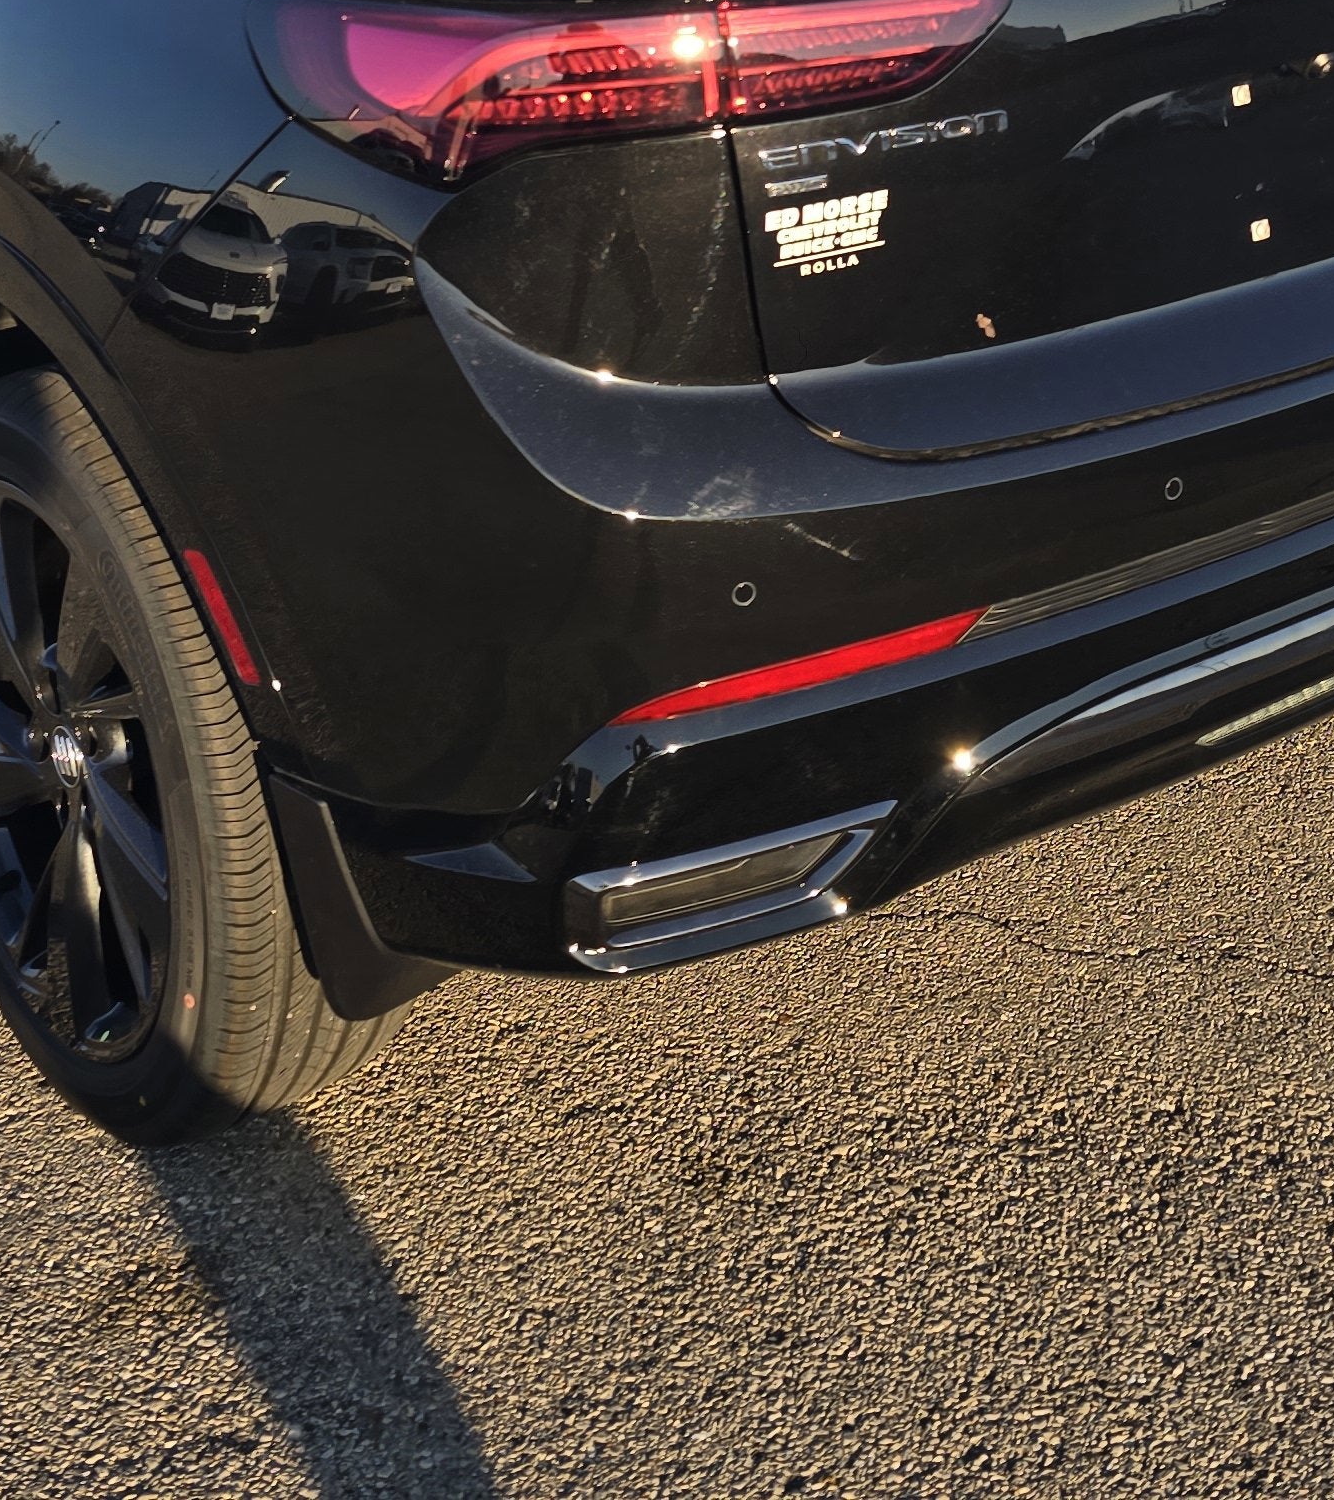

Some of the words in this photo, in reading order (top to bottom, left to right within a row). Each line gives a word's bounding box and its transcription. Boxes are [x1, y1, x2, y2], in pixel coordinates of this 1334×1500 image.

[764, 206, 800, 233] ED
[801, 188, 889, 225] MORSE
[776, 210, 882, 245] CHEVROLET
[799, 253, 860, 277] ROLLA
